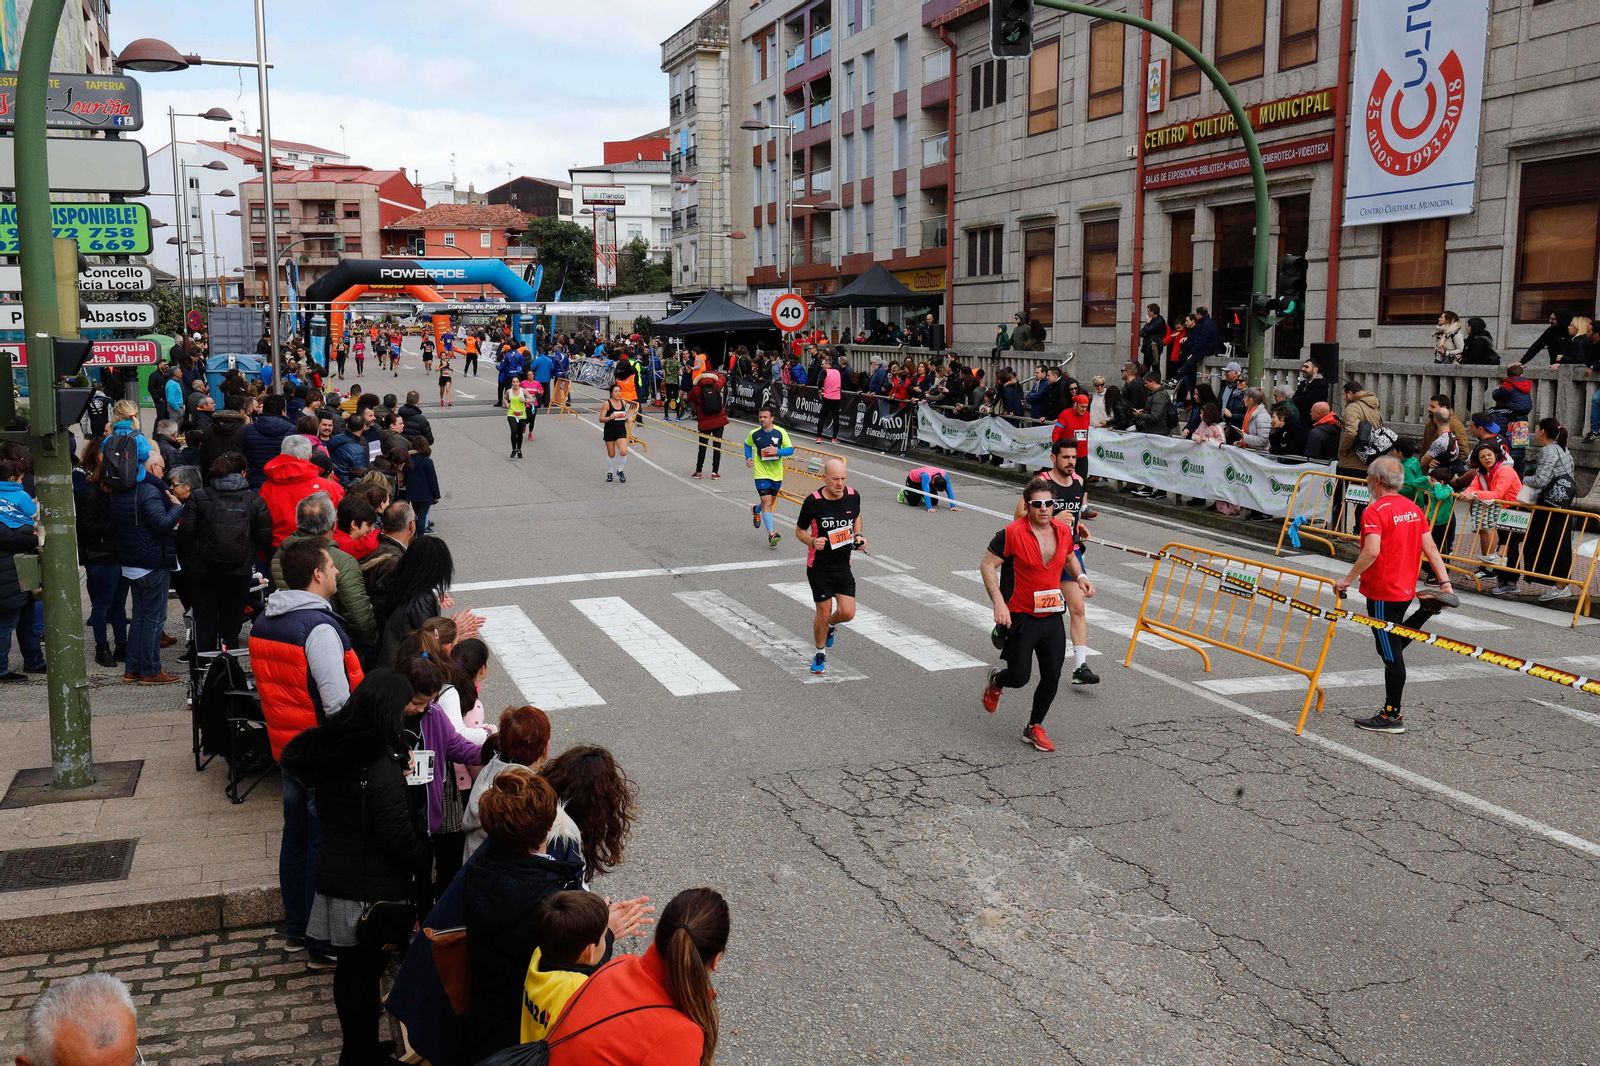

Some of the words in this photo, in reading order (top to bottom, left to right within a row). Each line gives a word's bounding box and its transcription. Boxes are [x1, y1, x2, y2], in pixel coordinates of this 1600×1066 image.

[85, 81, 126, 91] TAPERIA
[1367, 96, 1381, 120] 25
[1144, 124, 1187, 149] CENTRO
[1193, 111, 1251, 139] CULTUR
[1259, 91, 1332, 125] MUNICIPAL
[1404, 78, 1462, 172] 1993-2018
[1368, 130, 1393, 168] anos
[1145, 174, 1160, 185] SALAS
[1160, 172, 1168, 182] DE
[1360, 206, 1384, 216] CENTRO
[1384, 203, 1417, 214] CULTURAL
[1418, 199, 1454, 210] MUNICIPAL
[50, 207, 138, 225] ISPONIBLE!
[52, 228, 78, 238] 72
[88, 228, 135, 238] 758
[89, 240, 136, 251] 669
[83, 268, 143, 278] Concello
[380, 268, 466, 278] POWERADE
[79, 280, 103, 290] icía
[108, 280, 144, 290] Local
[85, 310, 147, 323] Abastos
[780, 307, 801, 319] 40
[91, 343, 149, 354] arroquial
[115, 353, 151, 363] María
[1105, 450, 1124, 460] RAMA
[1152, 456, 1168, 468] RAMA
[1189, 463, 1205, 475] RAMA
[1353, 489, 1371, 498] RAMA
[1510, 515, 1528, 525] RAMA
[836, 533, 847, 543] 371
[1041, 597, 1056, 608] 222
